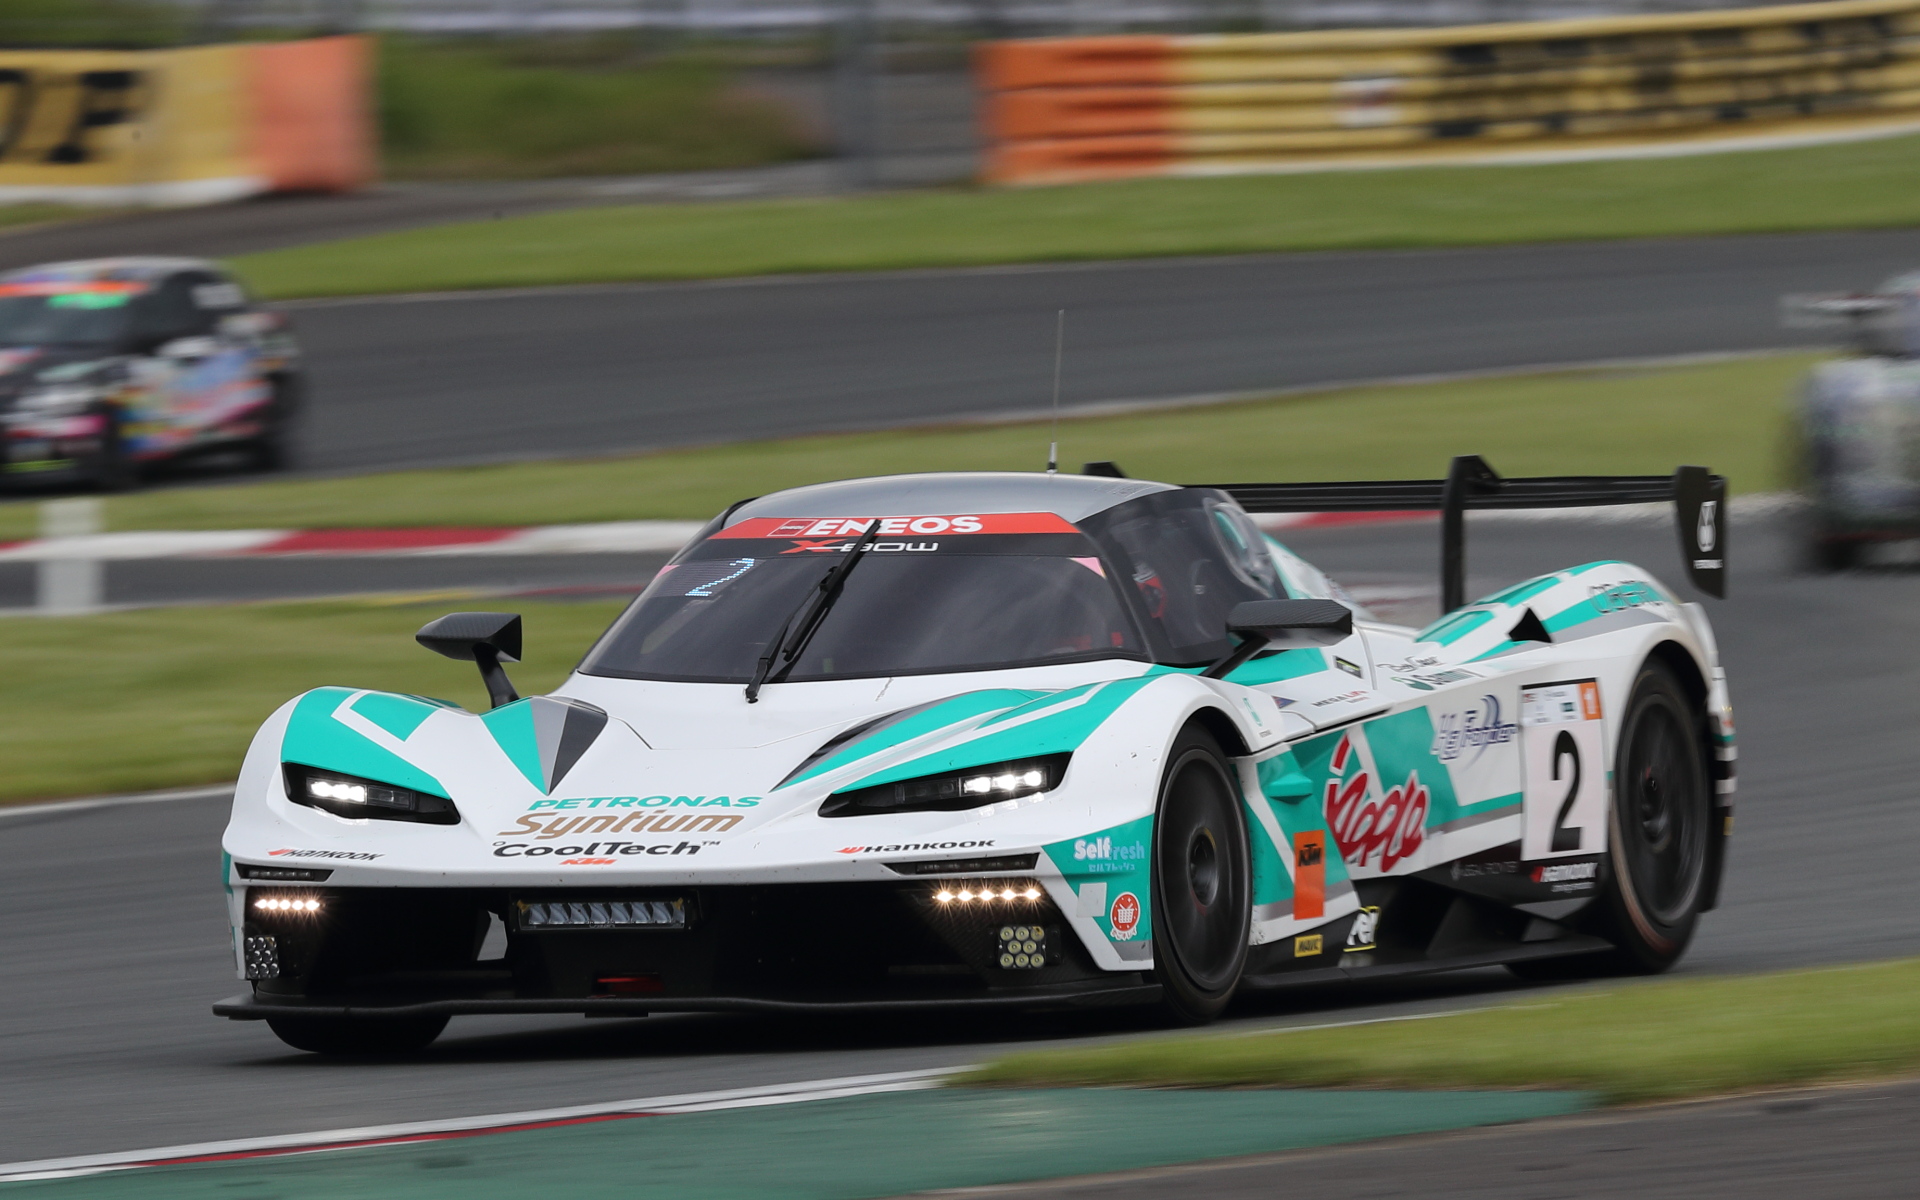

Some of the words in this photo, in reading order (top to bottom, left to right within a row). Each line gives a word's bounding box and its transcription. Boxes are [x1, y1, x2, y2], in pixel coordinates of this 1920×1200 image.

[804, 516, 984, 536] ENEOS
[685, 557, 755, 598] 2
[527, 795, 763, 811] PETRONAS
[1550, 730, 1583, 853] 2
[496, 810, 745, 840] Syntium
[559, 857, 618, 866] KTM
